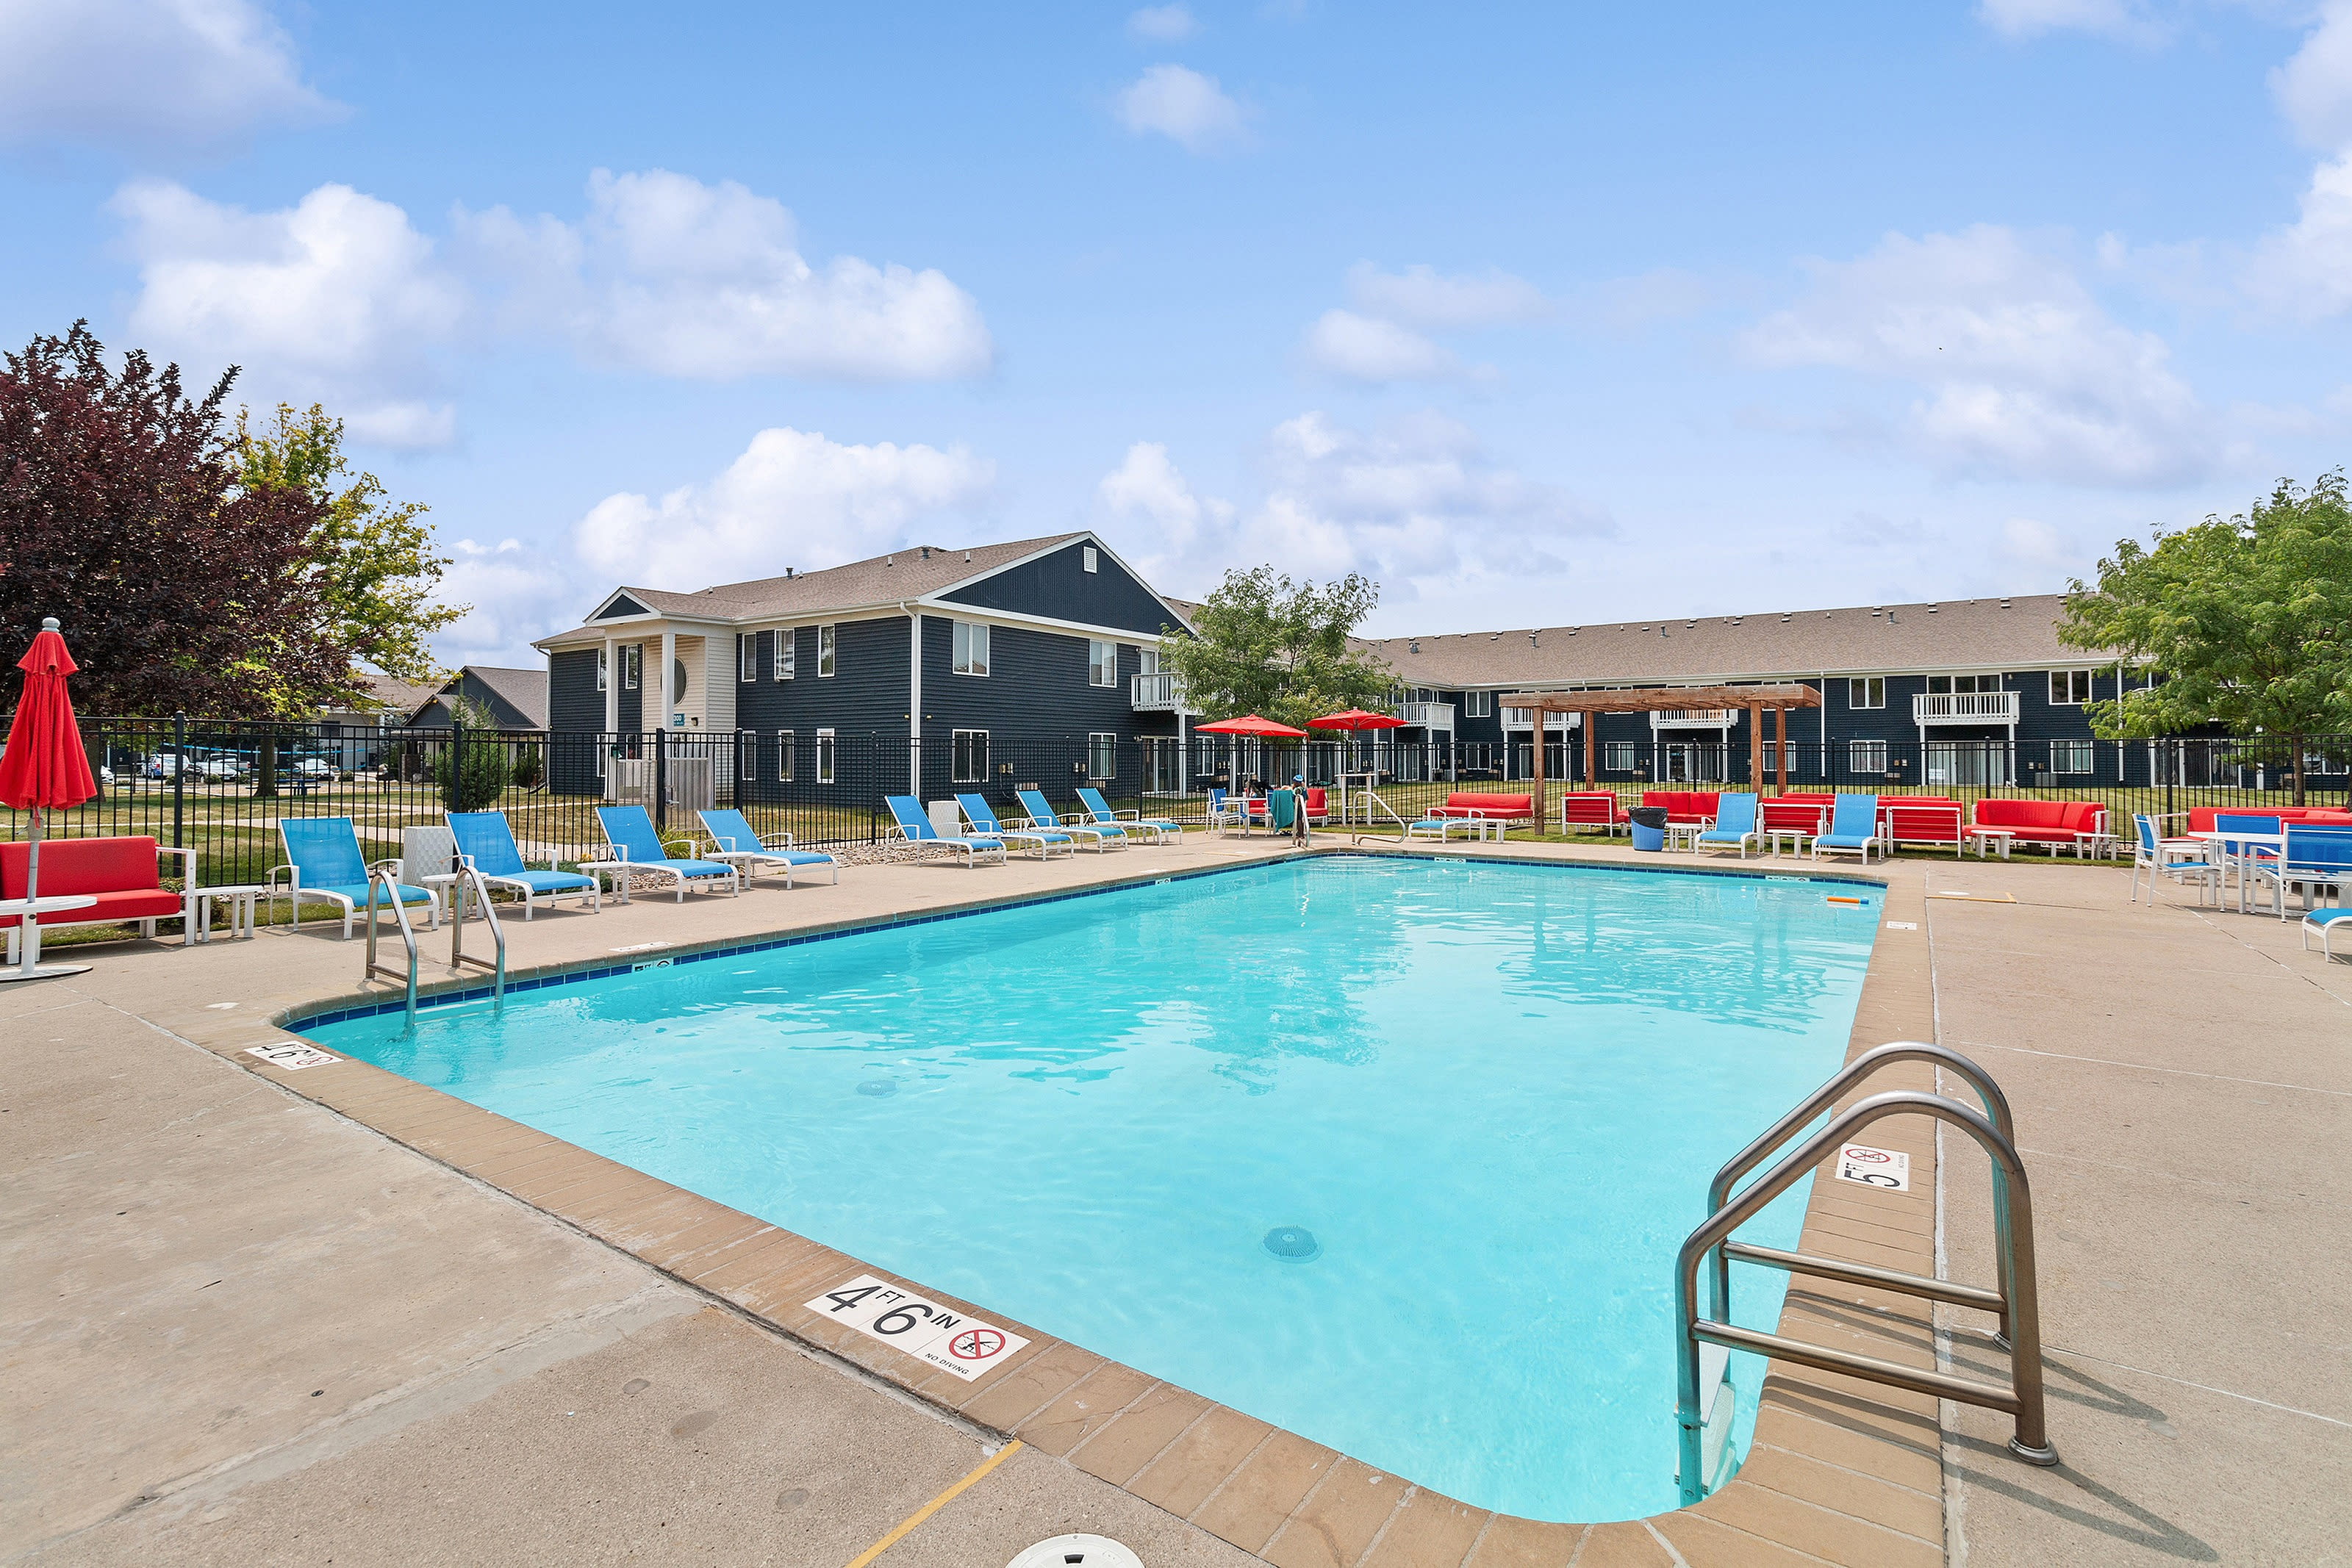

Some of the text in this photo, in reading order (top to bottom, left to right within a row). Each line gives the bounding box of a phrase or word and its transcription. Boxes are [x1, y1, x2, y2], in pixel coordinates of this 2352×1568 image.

[1844, 1170, 1900, 1187] 5
[825, 1285, 962, 1334] 4 FT 6 IN
[925, 1353, 969, 1375] NO DIVING
